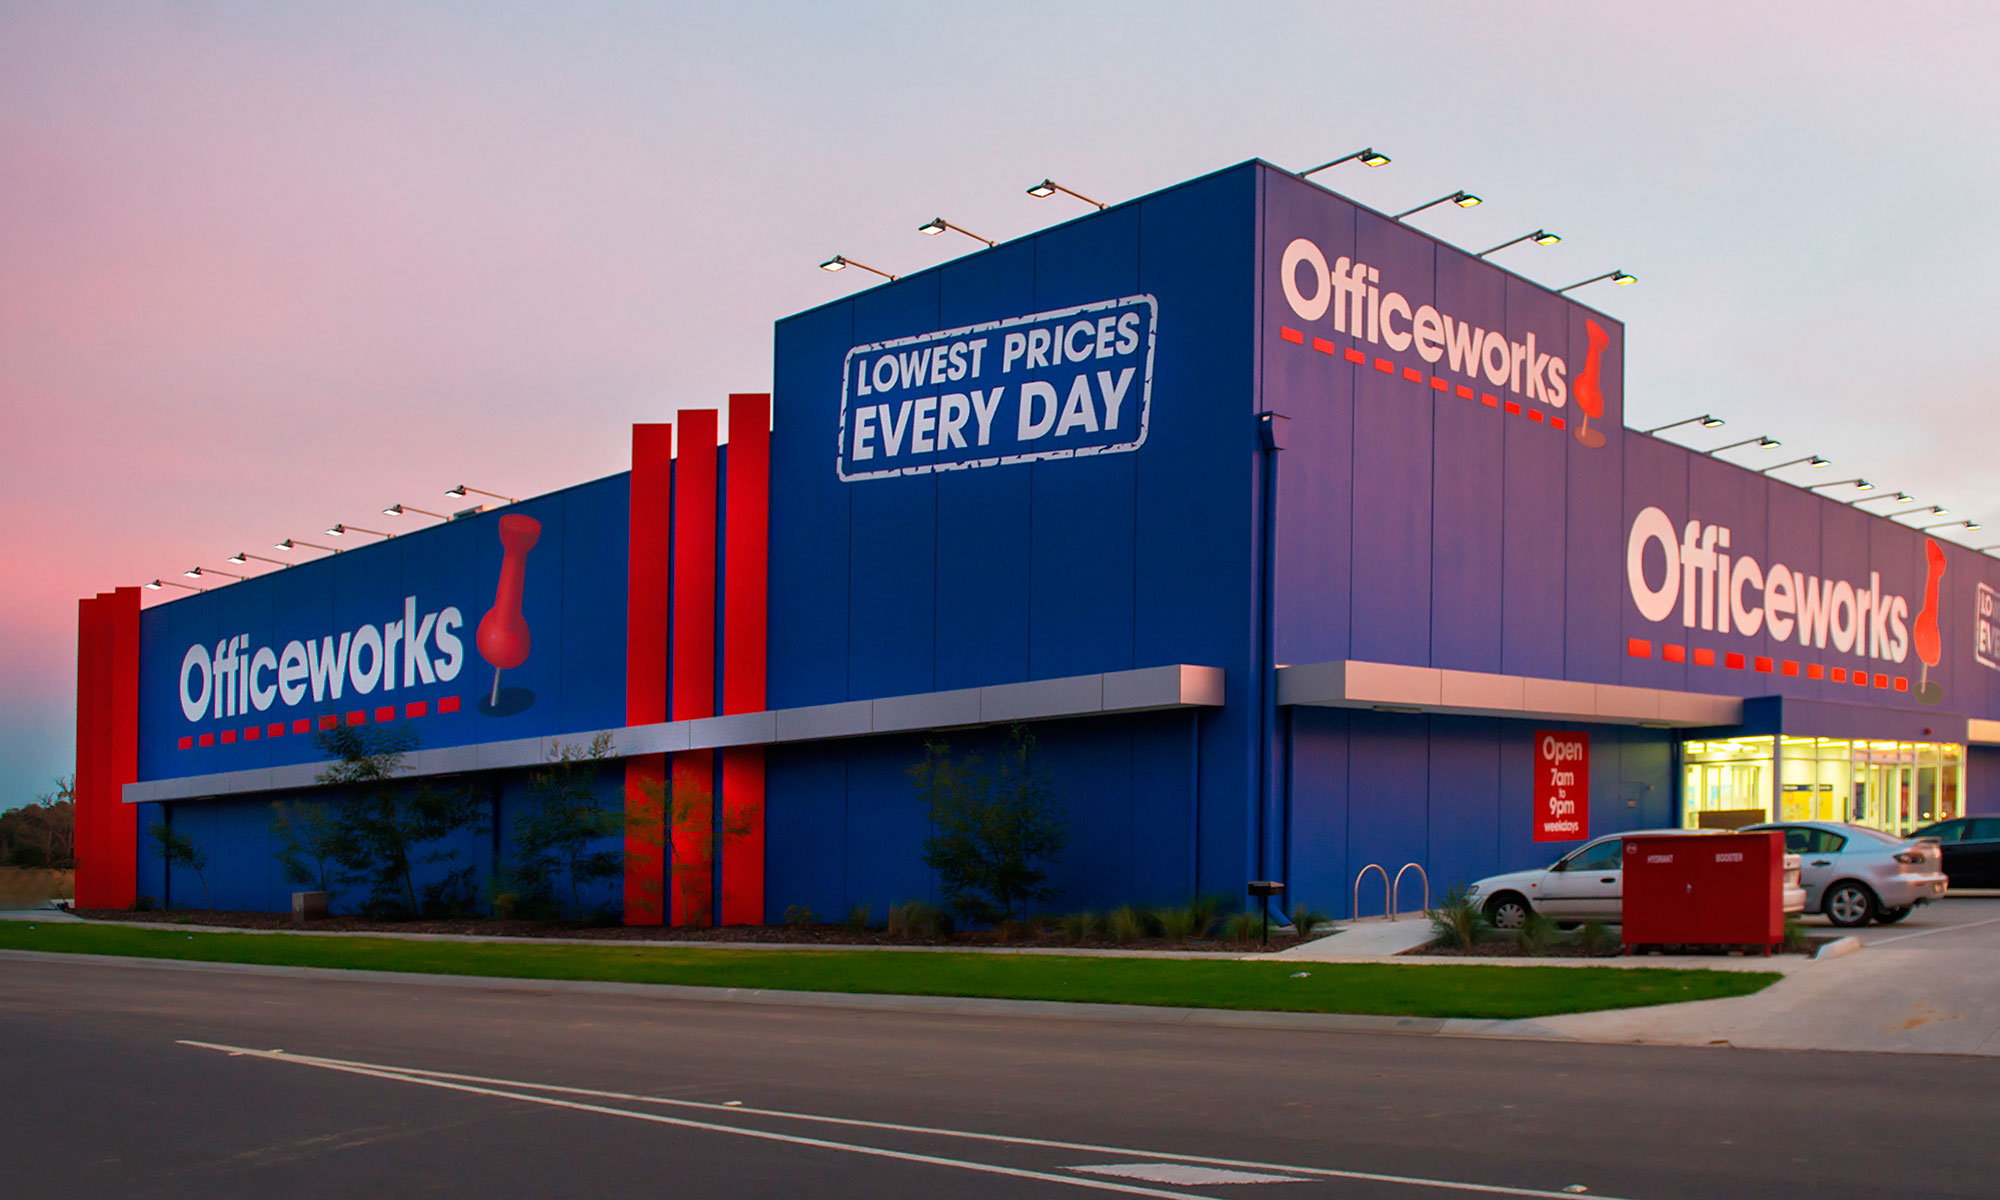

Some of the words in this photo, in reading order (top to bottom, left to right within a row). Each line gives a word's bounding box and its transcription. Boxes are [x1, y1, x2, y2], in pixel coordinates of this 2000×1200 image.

[1281, 238, 1567, 408] Officeworks
[857, 338, 987, 396] LOWEST
[1002, 312, 1140, 373] PRICES
[852, 386, 1005, 461] EVERY
[1017, 367, 1136, 441] DAY
[1627, 506, 1908, 663] Officeworks
[179, 595, 464, 722] Officeworks
[1543, 736, 1583, 766] Open
[1550, 768, 1574, 786] 7am
[1549, 796, 1574, 818] 9pm
[1558, 788, 1566, 799] to
[1543, 820, 1579, 834] weekdays
[1647, 854, 1674, 864] HYDRANT
[1715, 852, 1744, 863] BOOSTER
